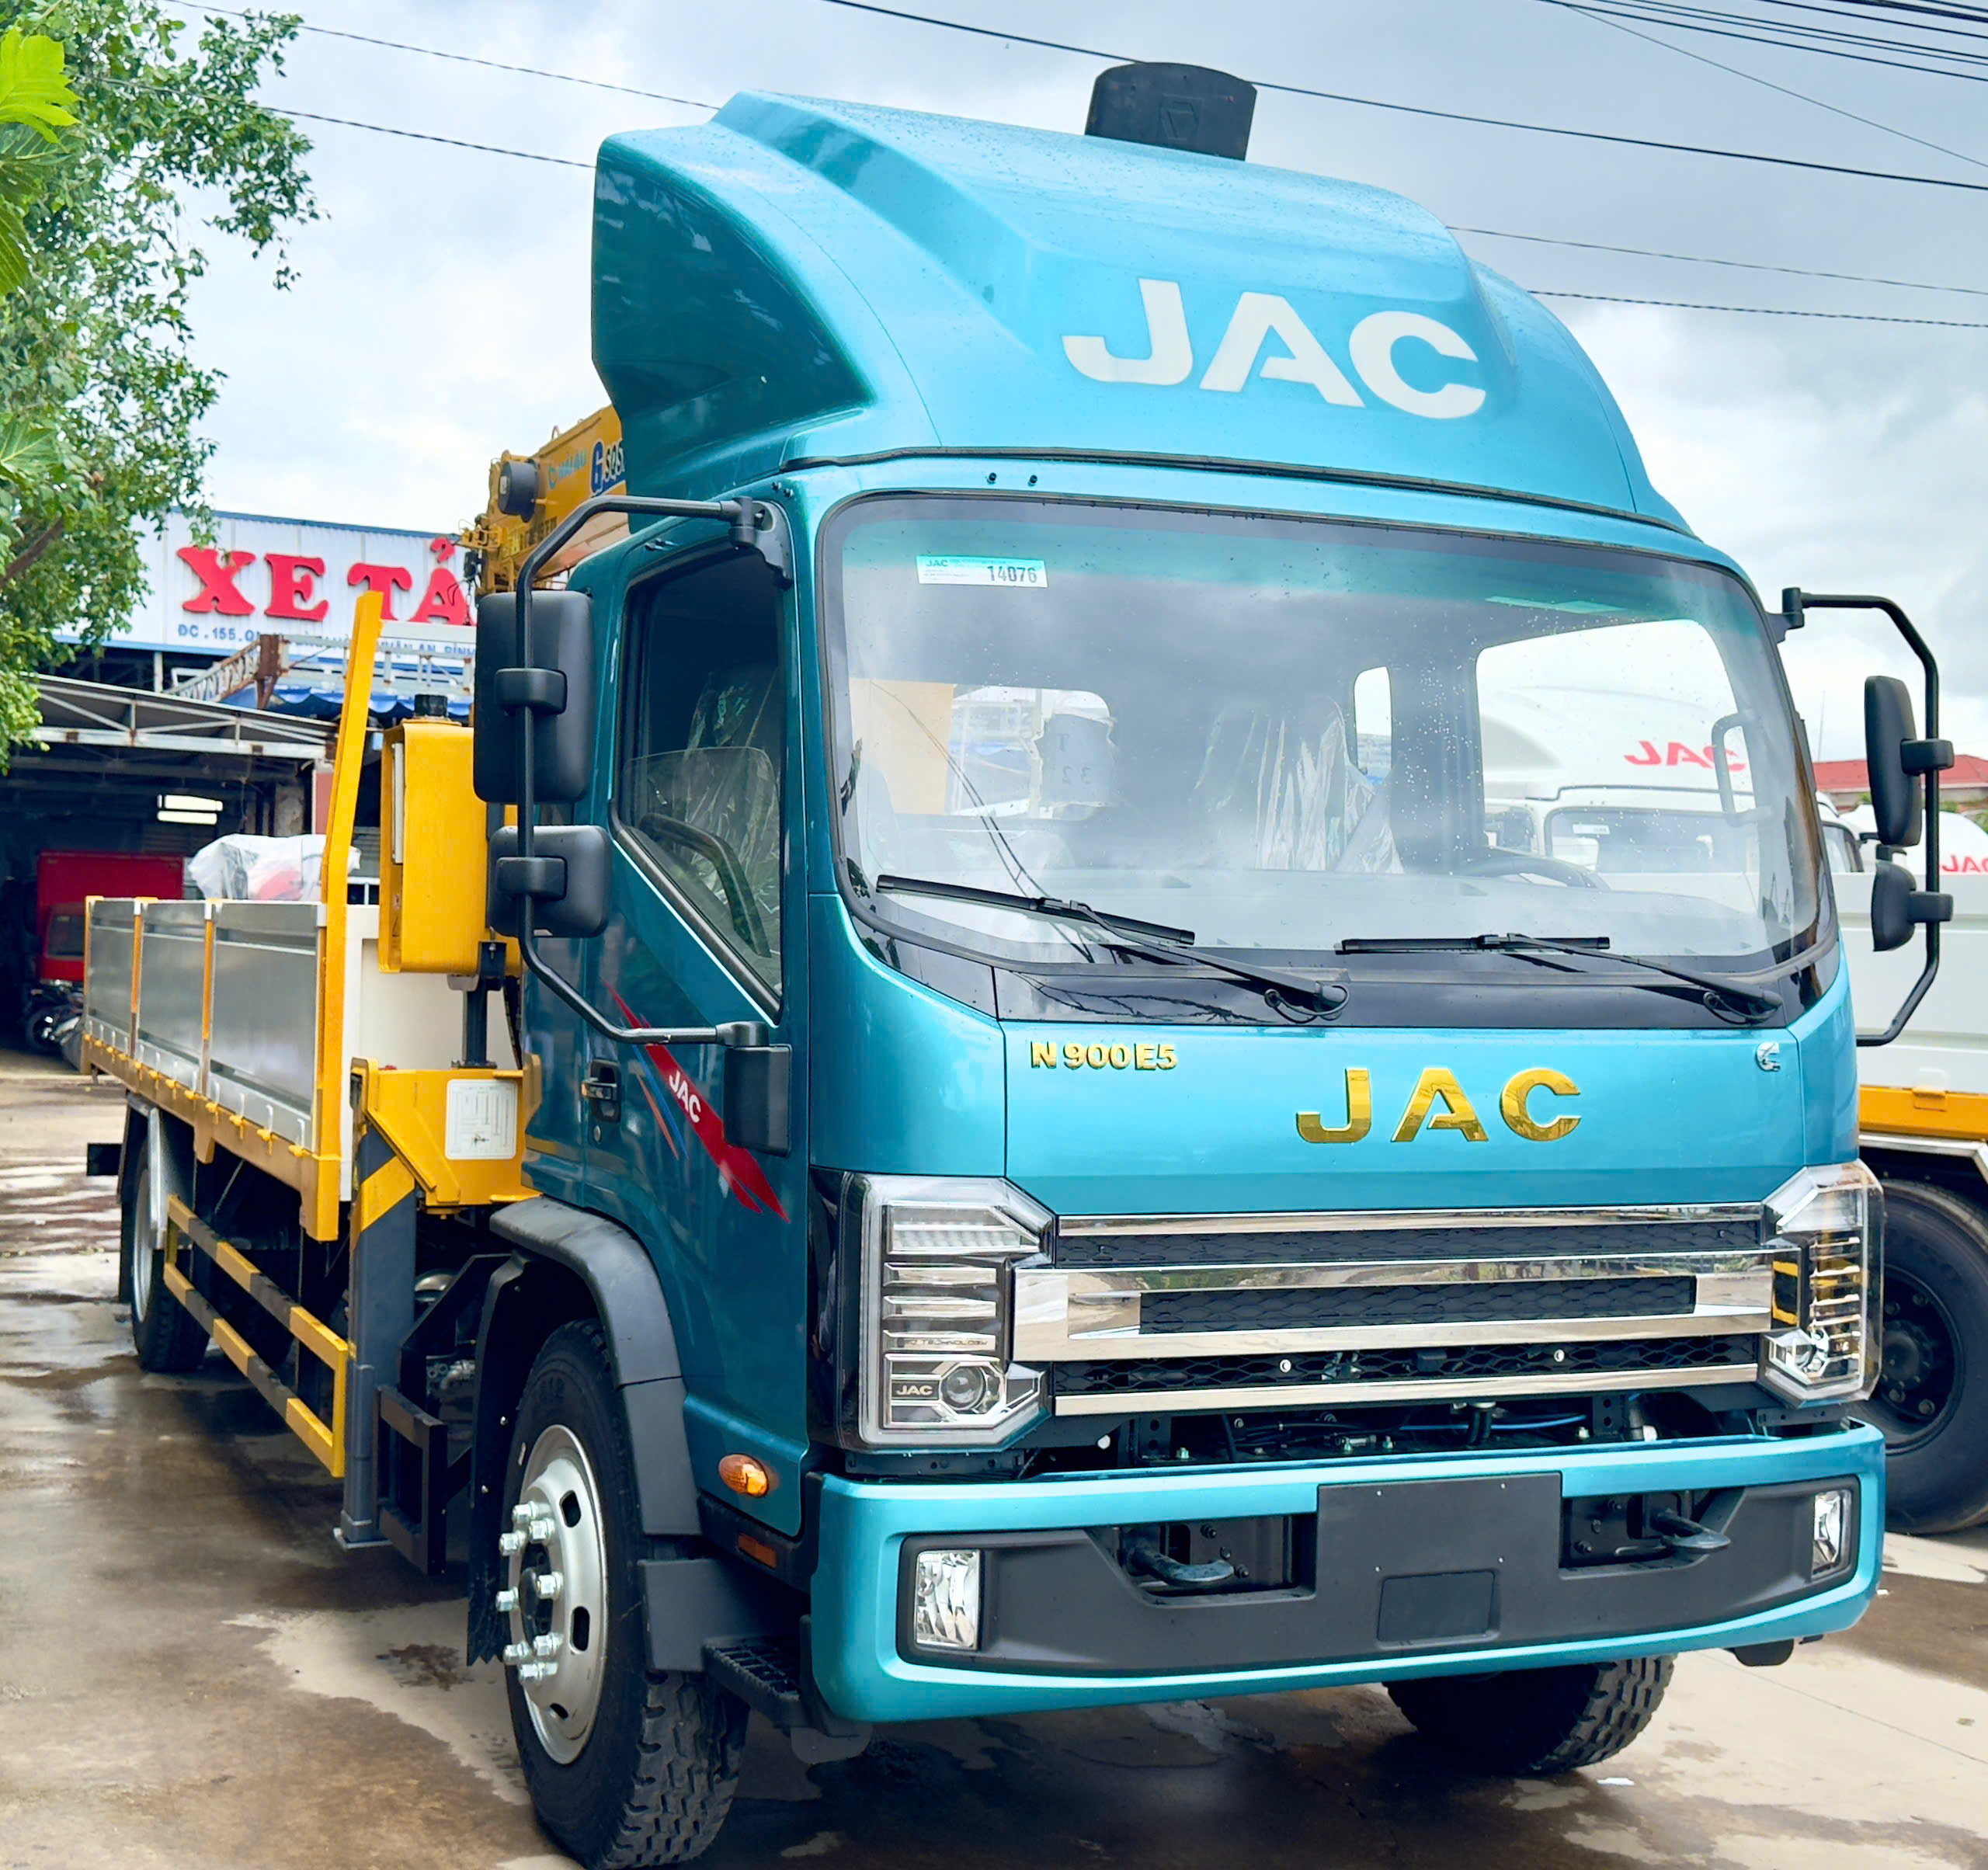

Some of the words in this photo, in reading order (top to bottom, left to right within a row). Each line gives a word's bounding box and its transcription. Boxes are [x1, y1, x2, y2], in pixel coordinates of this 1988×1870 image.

[1062, 278, 1486, 419] JAC
[177, 545, 329, 622] XE
[347, 537, 476, 627] TẢ
[988, 565, 1037, 583] 14076
[669, 1071, 701, 1123] JAC
[1296, 1068, 1582, 1142] JAC
[896, 1385, 933, 1396] JAC
